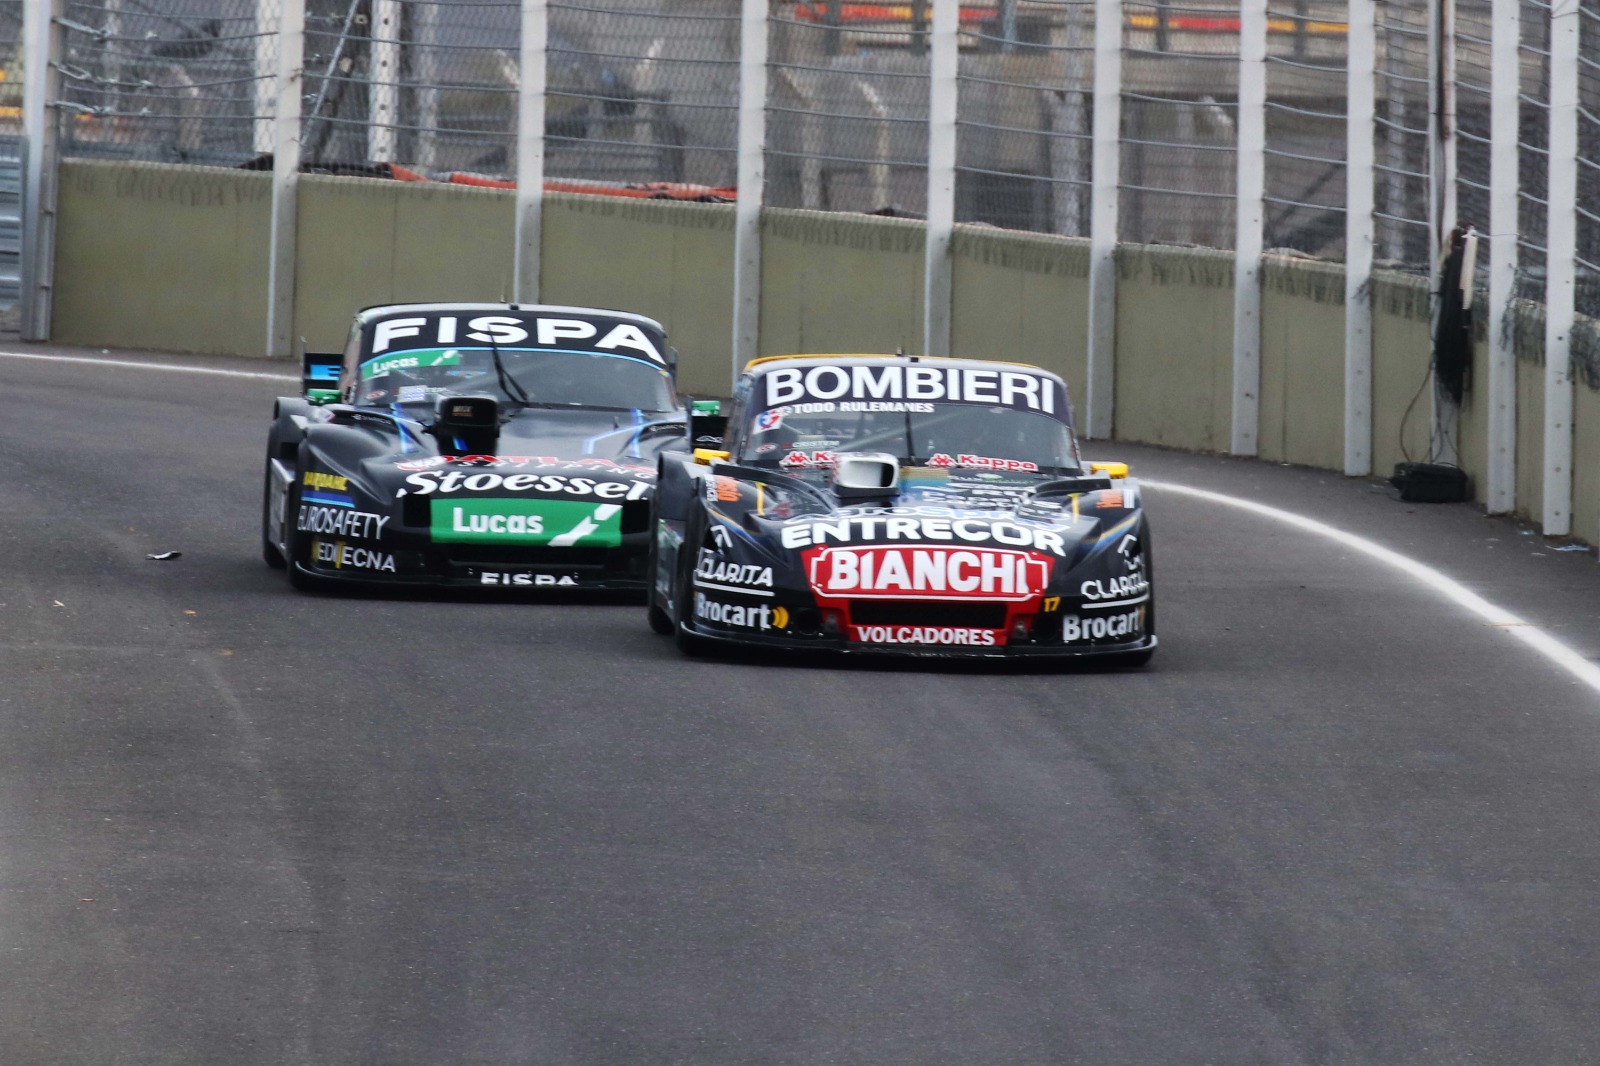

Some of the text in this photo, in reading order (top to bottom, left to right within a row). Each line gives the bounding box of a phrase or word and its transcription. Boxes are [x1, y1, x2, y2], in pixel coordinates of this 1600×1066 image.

[372, 316, 666, 365] FISPA
[372, 357, 419, 374] Lucas
[766, 366, 1053, 414] BOMBIERI
[793, 402, 934, 414] TODO RULEMANES
[961, 455, 1036, 472] Kappa
[396, 470, 656, 501] Stoessel
[298, 505, 390, 540] EUROSAFETY
[453, 507, 543, 534] Lucas
[781, 517, 1066, 558] ENTRECOR
[696, 558, 773, 587] CLARITA
[827, 550, 1030, 595] BIANCHI
[697, 592, 772, 630] Brocart
[1044, 597, 1061, 612] 17
[857, 625, 995, 646] VOLCADORES
